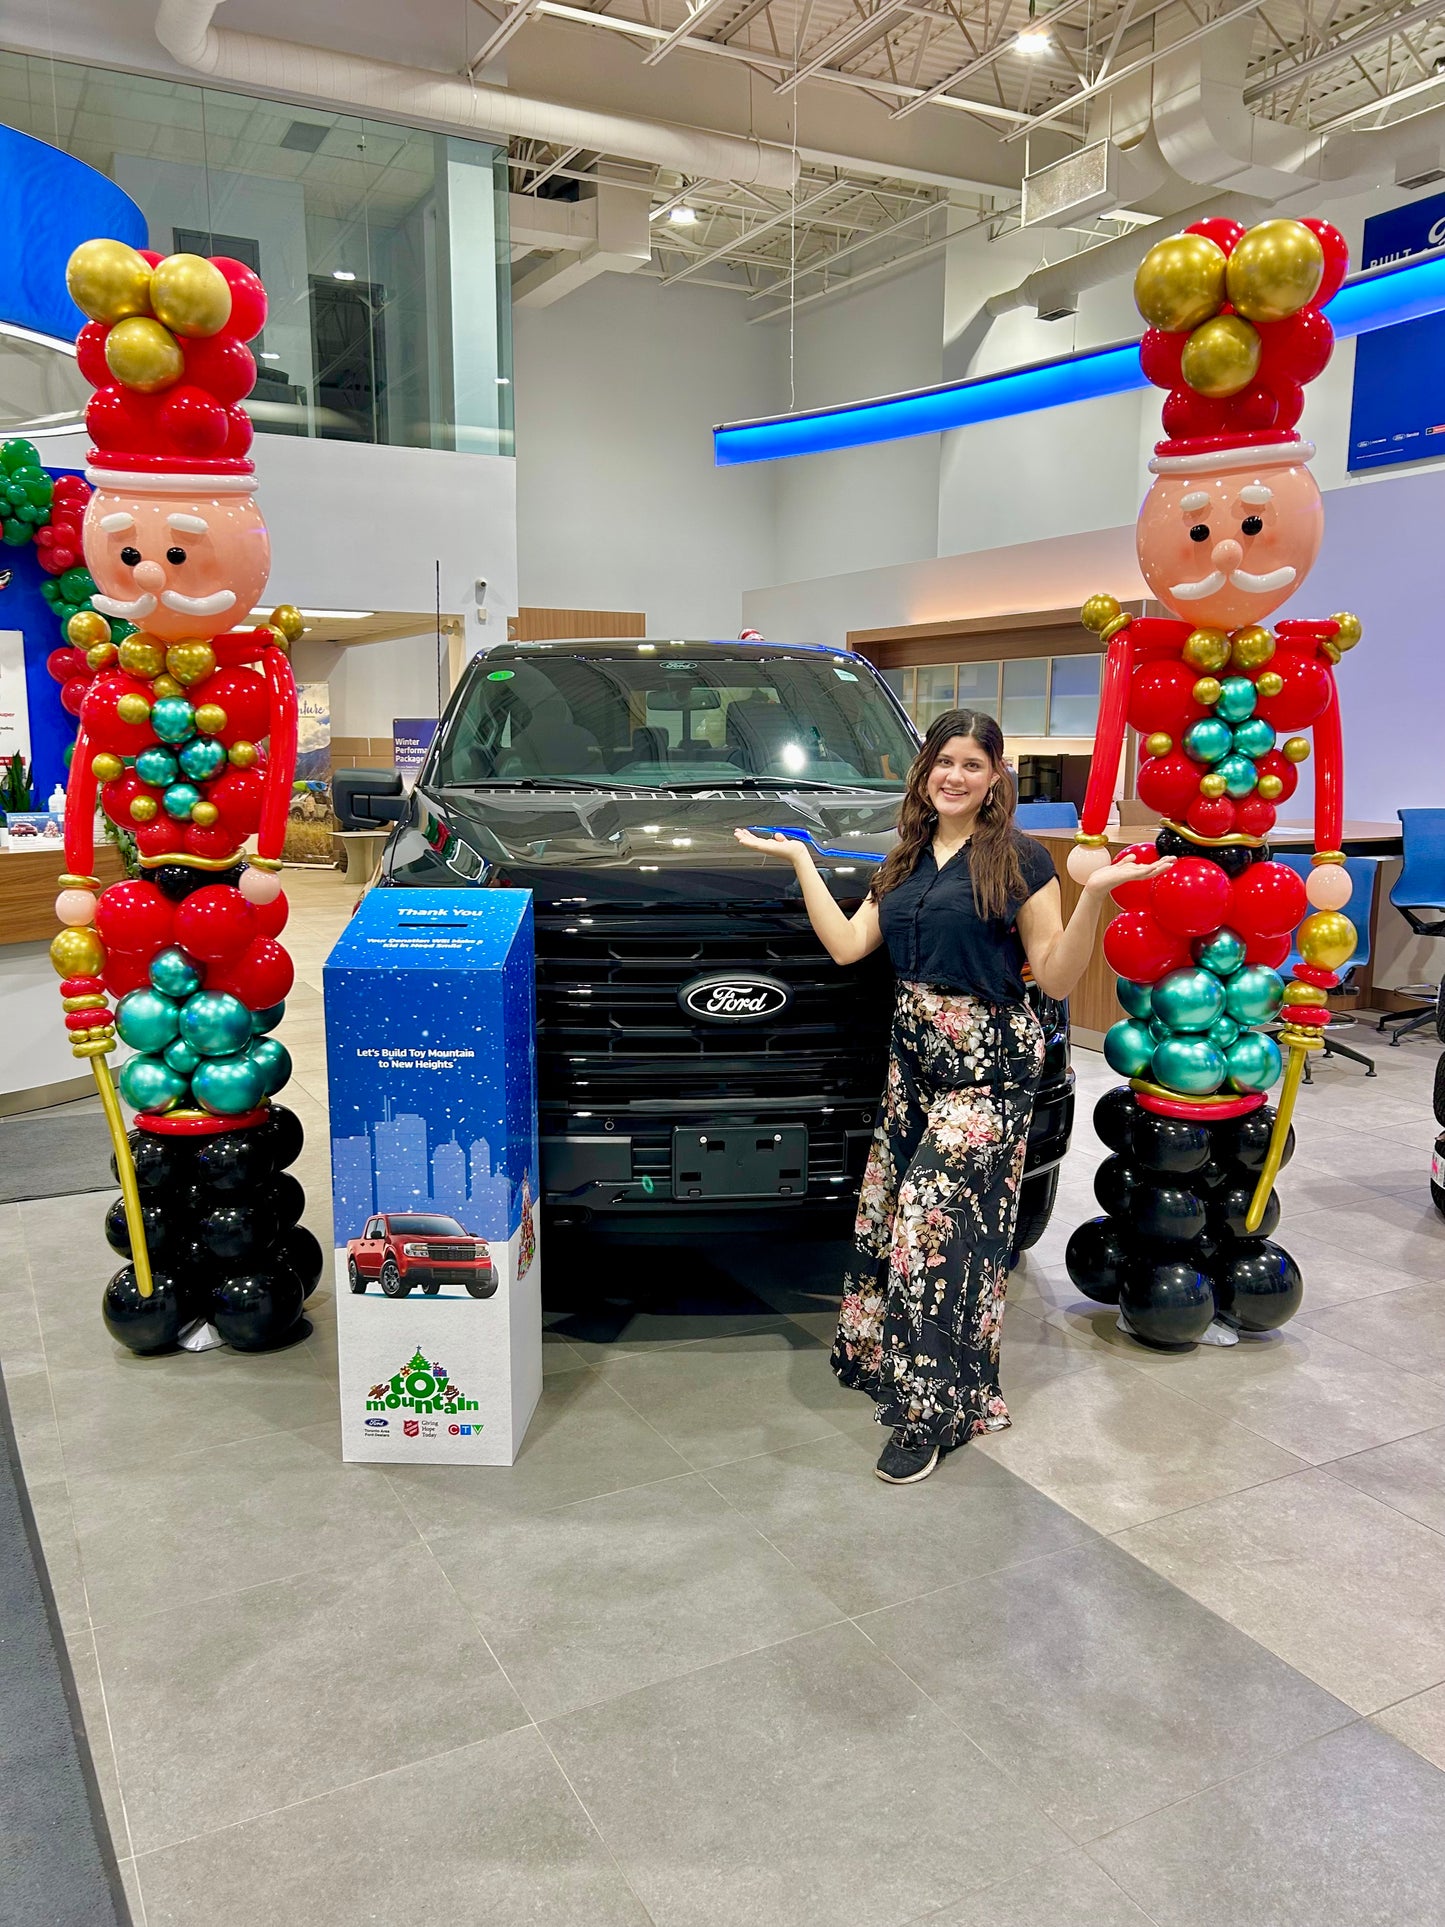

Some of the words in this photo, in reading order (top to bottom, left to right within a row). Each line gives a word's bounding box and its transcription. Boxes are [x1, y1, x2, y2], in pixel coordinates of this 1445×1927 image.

[397, 908, 449, 916] Thank
[453, 909, 484, 917] You
[706, 986, 768, 1012] Ford
[356, 1048, 380, 1057] Let's
[382, 1048, 407, 1057] Build
[409, 1048, 426, 1059] Toy
[427, 1048, 475, 1058] Mountain
[378, 1060, 390, 1068] to
[391, 1060, 414, 1068] New
[415, 1060, 454, 1070] Heights
[366, 1393, 479, 1414] mountain
[448, 1424, 484, 1436] CTV
